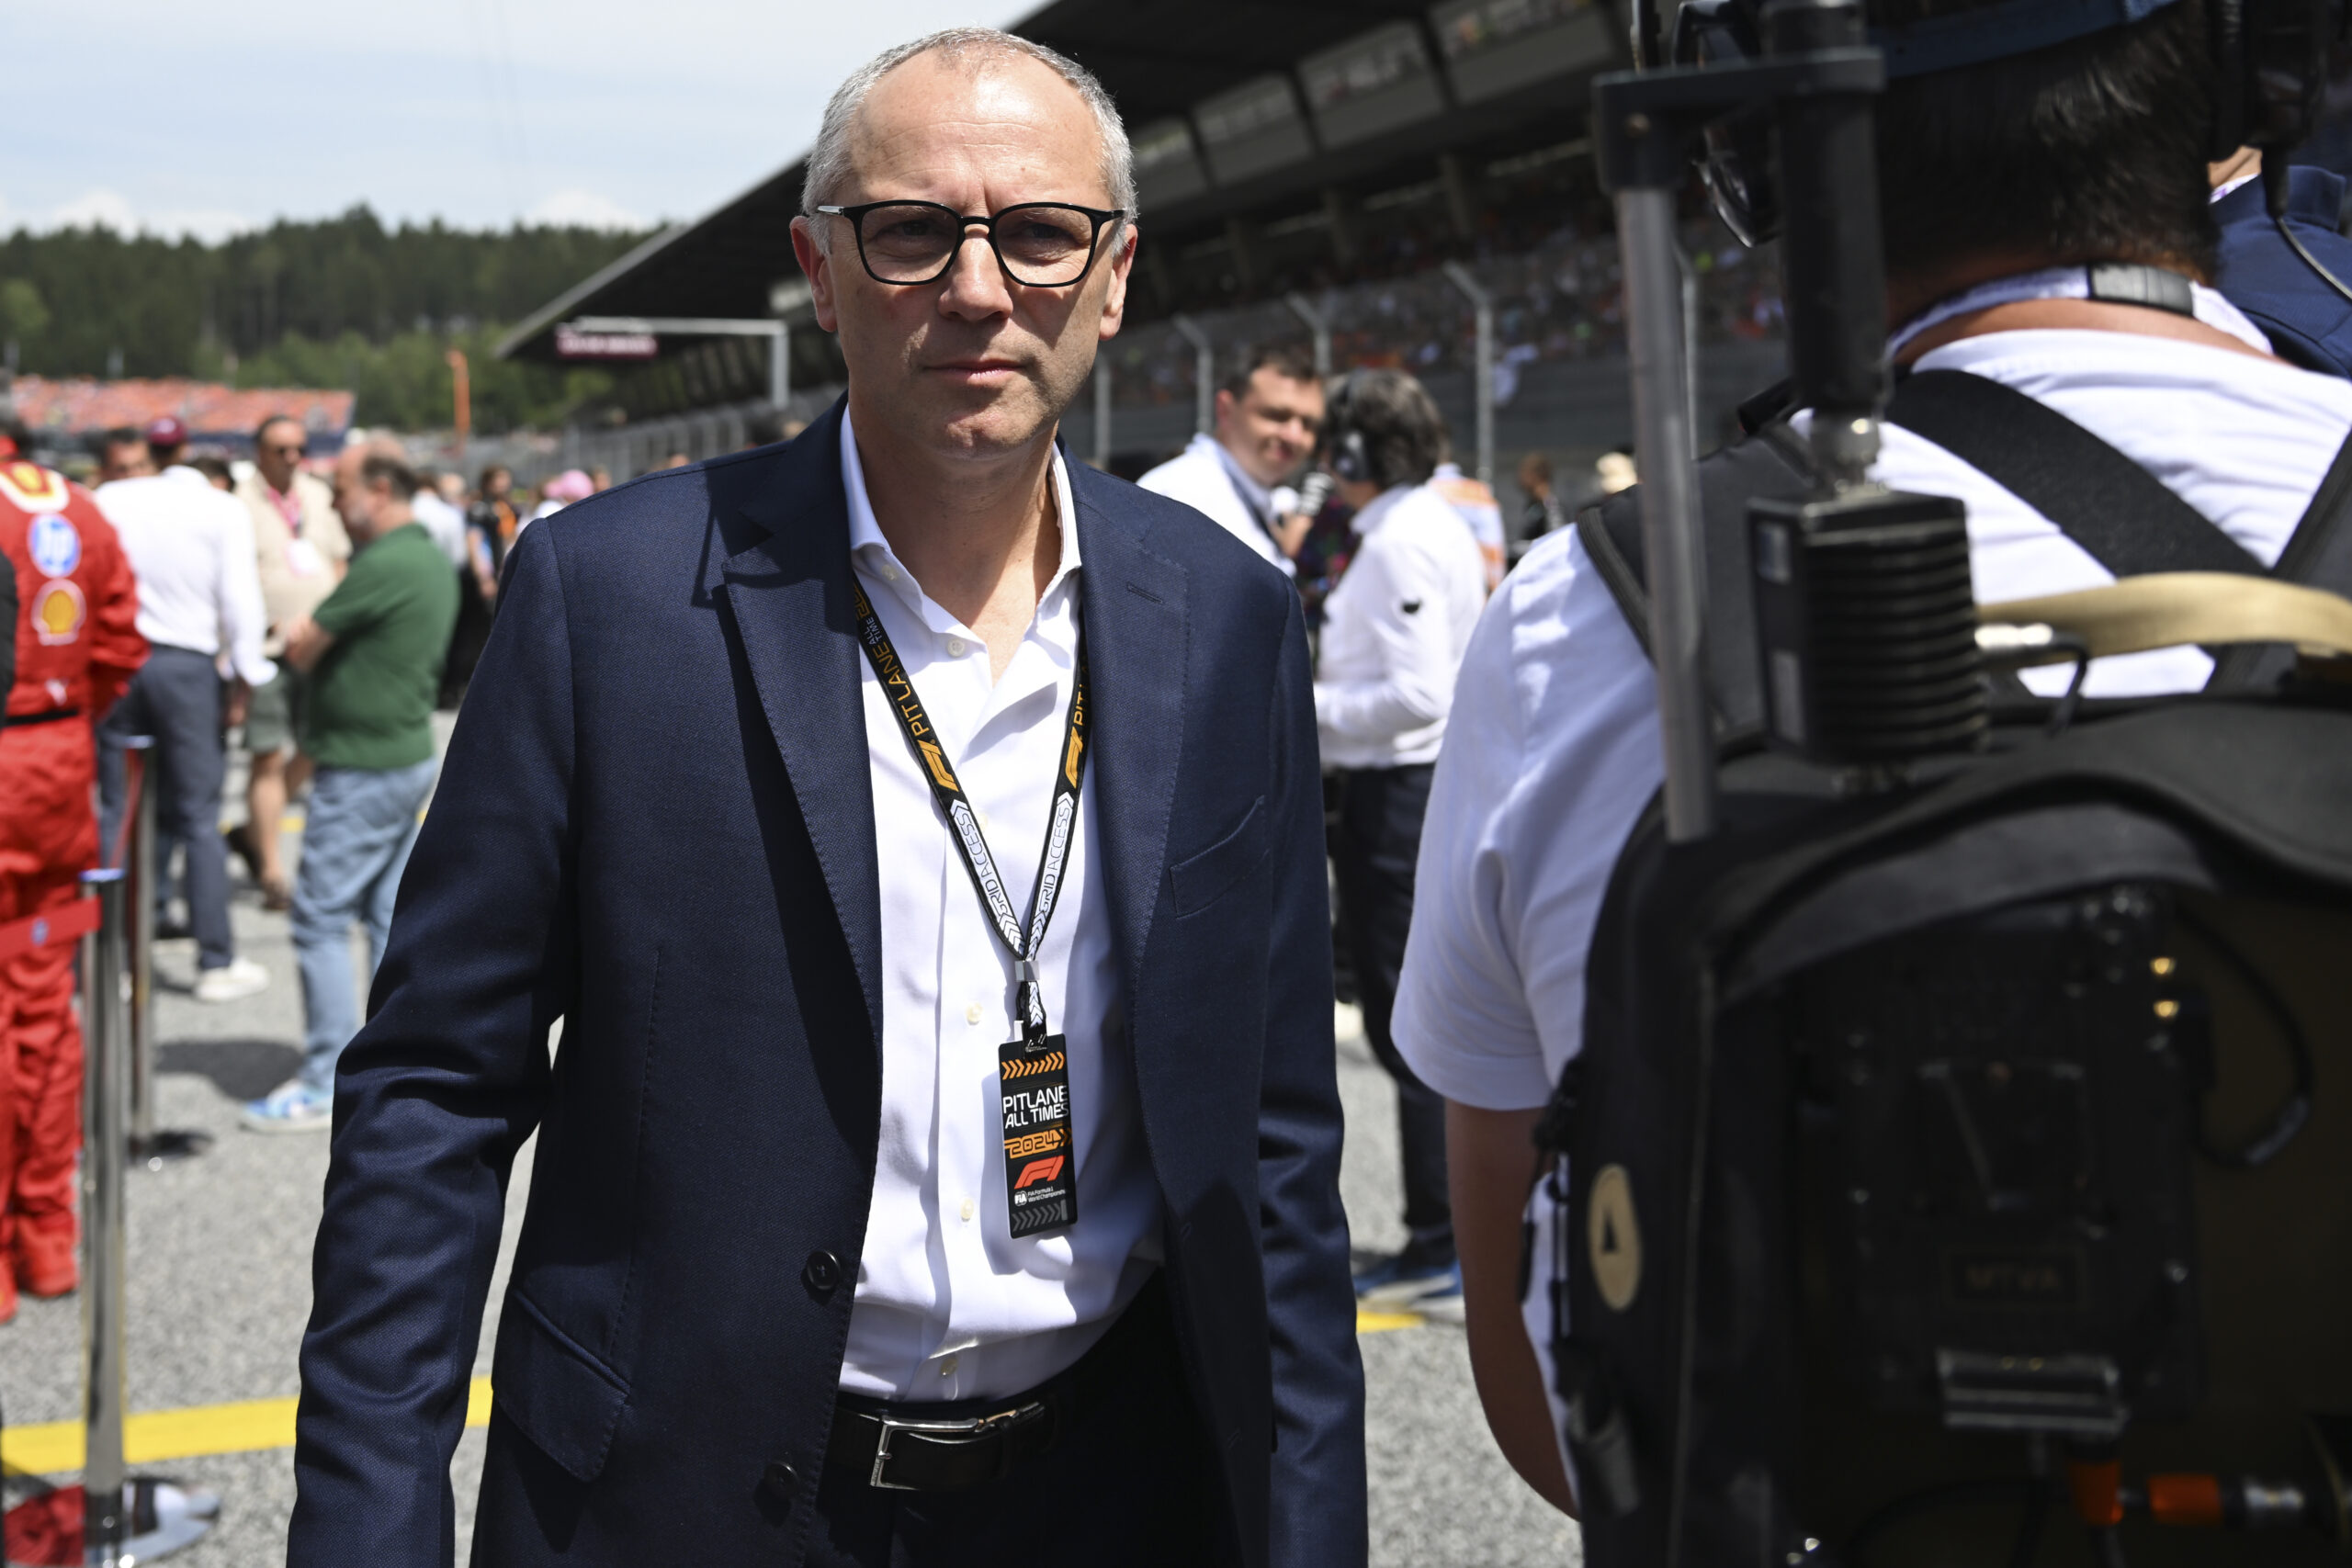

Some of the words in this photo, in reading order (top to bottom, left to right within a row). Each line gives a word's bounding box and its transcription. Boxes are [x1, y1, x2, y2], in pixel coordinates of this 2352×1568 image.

[864, 626, 876, 645] ALL
[866, 616, 883, 643] TIME
[873, 641, 911, 702] LANE
[901, 704, 930, 737] PIT
[956, 812, 992, 878] ACCESS
[1046, 807, 1070, 871] ACCESS
[985, 878, 1009, 917] GRID
[1039, 874, 1056, 913] GRID
[1002, 1085, 1068, 1114] PITLANE
[1005, 1111, 1029, 1130] ALL
[1030, 1102, 1069, 1123] TIMES
[1007, 1131, 1059, 1156] 2024
[1014, 1192, 1027, 1205] FIA
